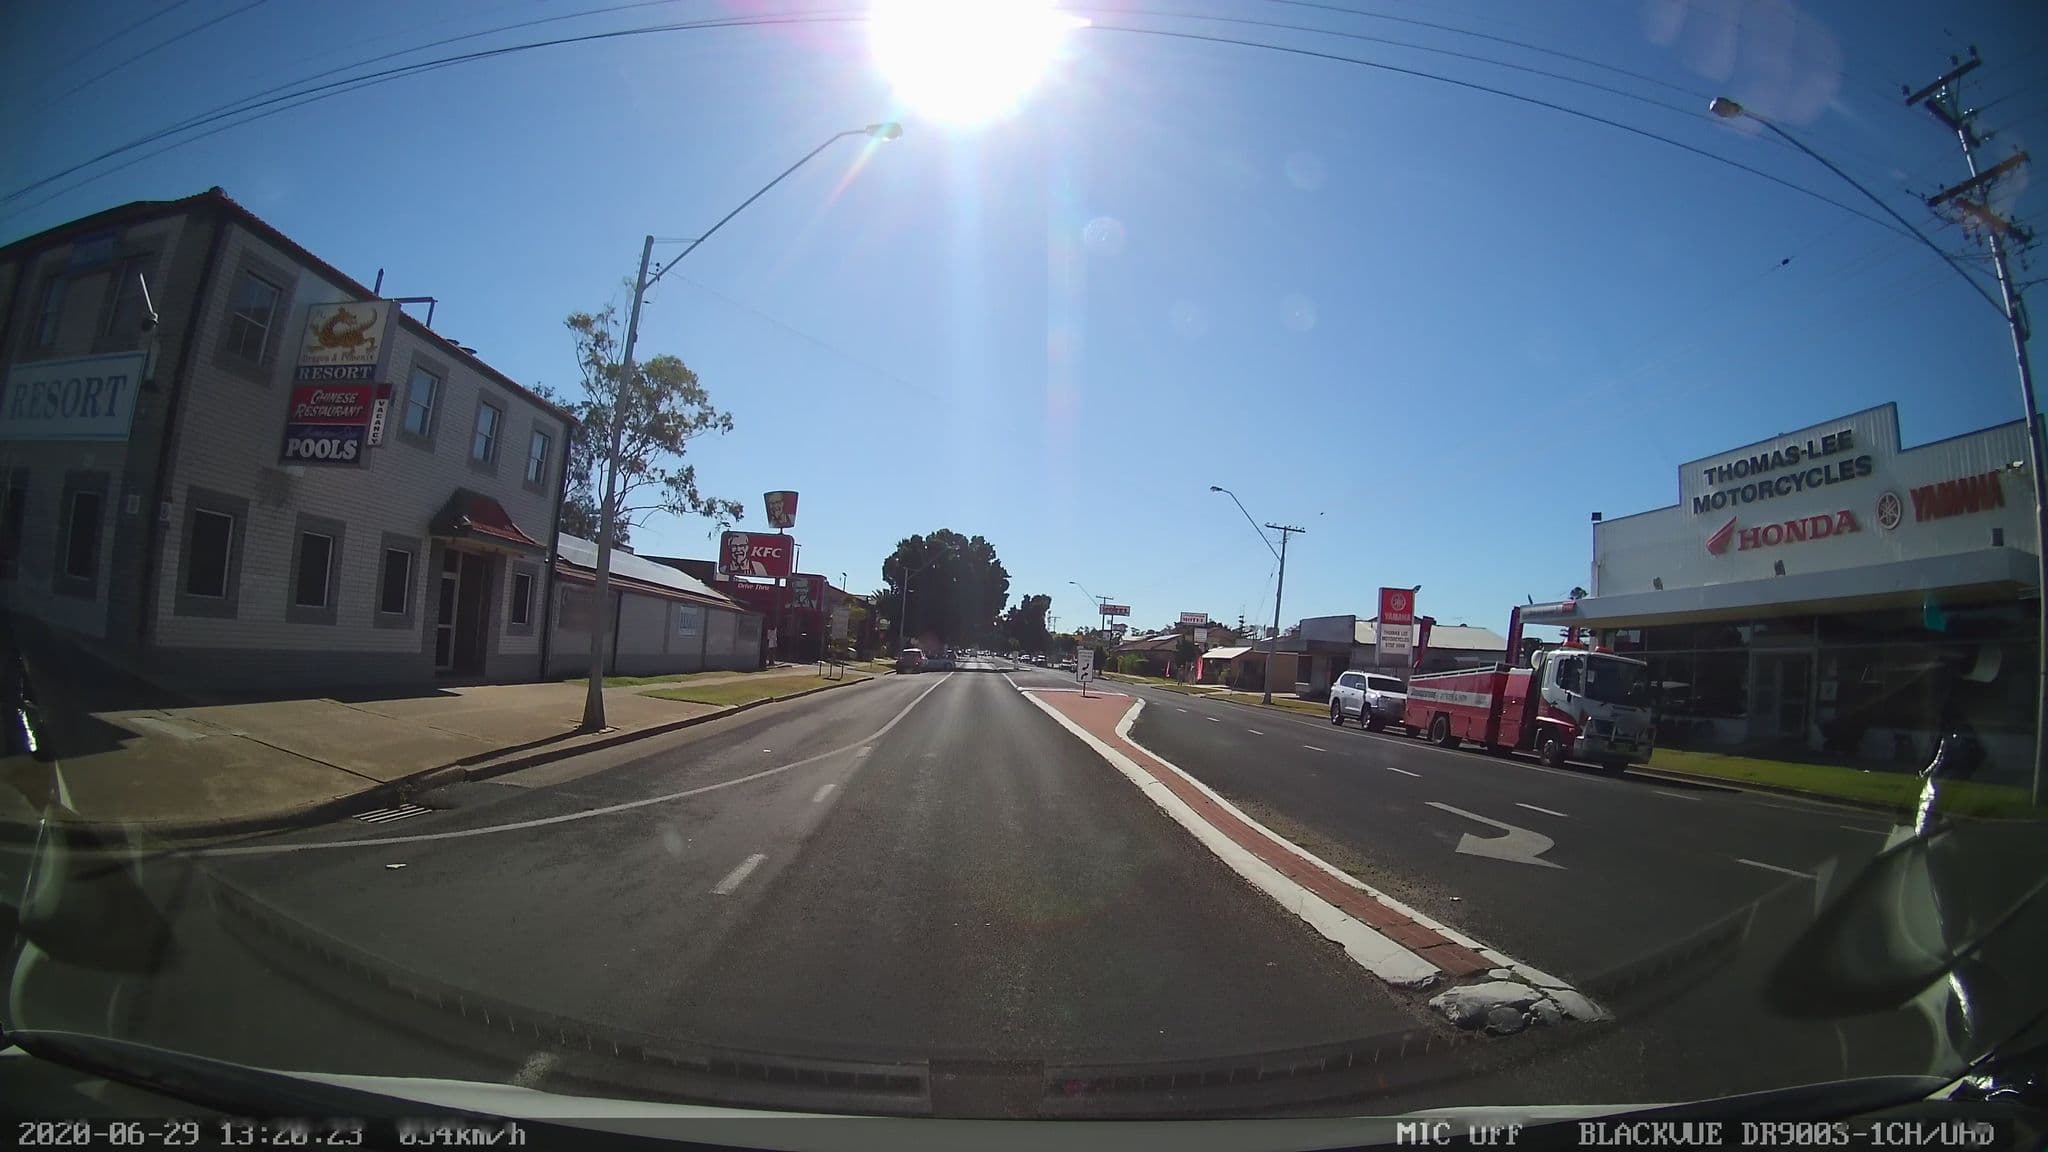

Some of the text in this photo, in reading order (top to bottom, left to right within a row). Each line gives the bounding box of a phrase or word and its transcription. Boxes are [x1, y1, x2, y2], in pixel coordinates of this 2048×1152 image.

[299, 366, 372, 380] RESORT
[10, 375, 128, 419] RESORT
[295, 403, 364, 418] RESTAURANT
[310, 389, 359, 405] CHINESE
[371, 400, 385, 444] VACANCY
[285, 438, 358, 460] POOLS
[1703, 429, 1854, 486] THOMAS-LEE
[1693, 455, 1873, 515] MOTORCYCLES
[1909, 470, 2006, 522] YAMAHA
[1738, 509, 1861, 552] HONDA
[750, 546, 782, 558] KFC
[1384, 612, 1411, 621] YAMAHA
